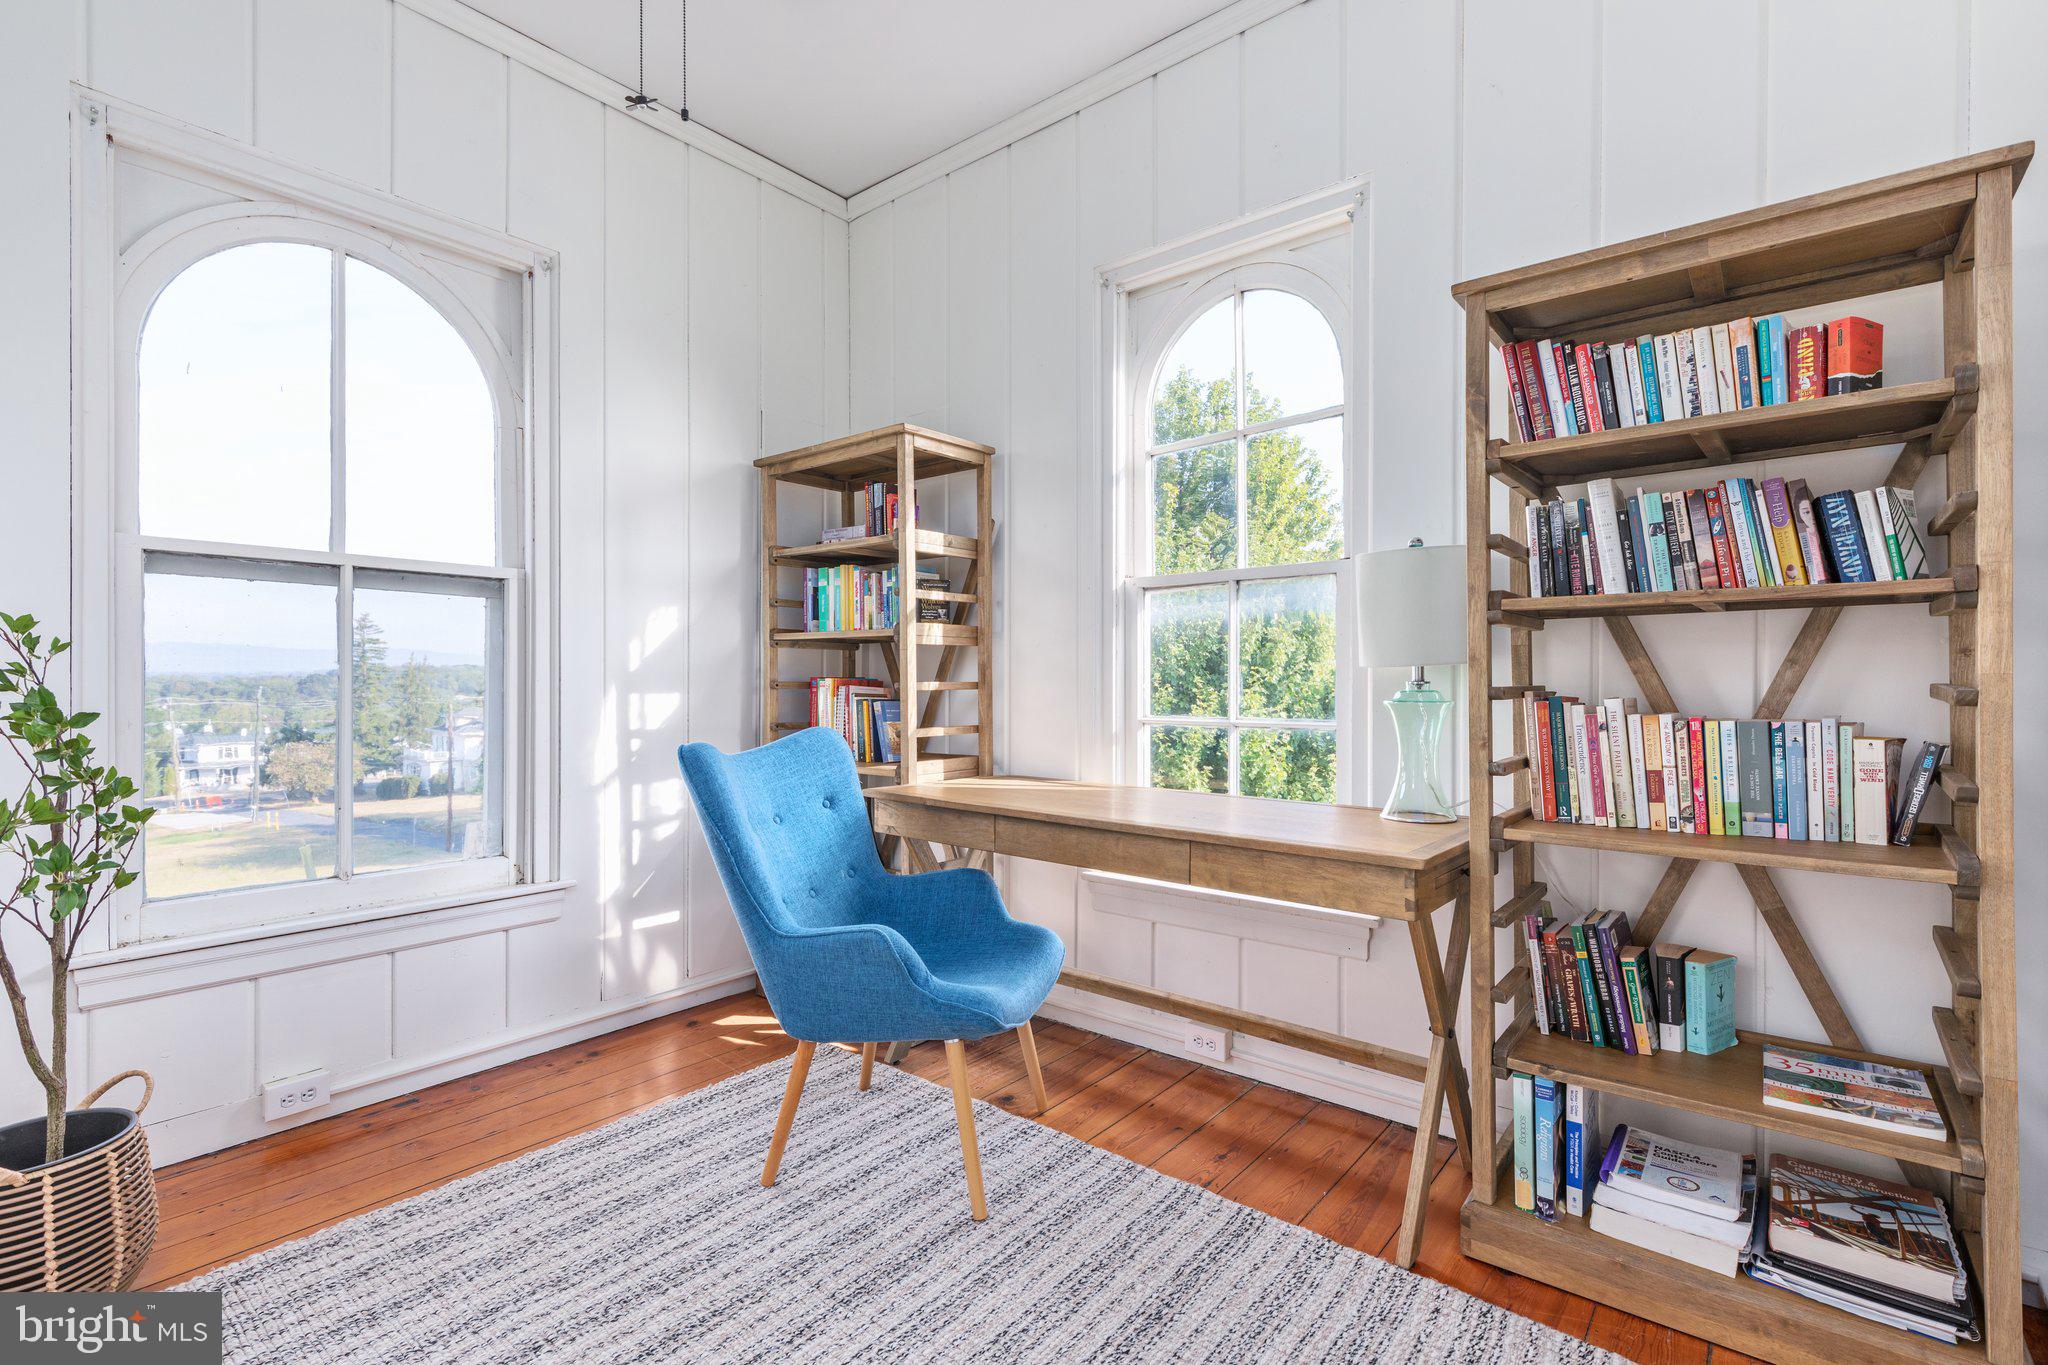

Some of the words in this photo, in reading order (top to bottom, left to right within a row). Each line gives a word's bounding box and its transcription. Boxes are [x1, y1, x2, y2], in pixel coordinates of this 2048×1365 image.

[1520, 346, 1530, 357] THE
[1523, 359, 1532, 367] DA
[1578, 350, 1589, 377] CHELSEA
[1525, 367, 1535, 383] VINCI
[1558, 373, 1566, 388] People
[1567, 364, 1578, 384] MYTH
[1528, 384, 1538, 398] CODE
[1583, 377, 1593, 404] HANDLER
[1532, 402, 1541, 414] DAN
[1570, 385, 1586, 425] CONTAGION
[1534, 415, 1546, 436] BROWN
[1772, 492, 1780, 503] The
[1665, 510, 1674, 523] CITY
[1735, 510, 1743, 520] the
[1769, 502, 1785, 523] Help
[1825, 494, 1850, 528] AYN
[1737, 521, 1746, 537] lotus
[1623, 540, 1630, 548] Go
[1669, 532, 1679, 555] THIEVES
[1715, 538, 1725, 556] Life
[1570, 553, 1579, 567] KITE
[1653, 539, 1661, 572] TRAVELER'S
[1718, 555, 1727, 565] of
[1835, 533, 1863, 578] RAND
[1721, 566, 1730, 576] Pi
[1571, 569, 1581, 594] RUNNER
[1611, 725, 1619, 747] SILENT
[1575, 724, 1586, 774] Transcendence
[1774, 747, 1782, 764] BELL
[1826, 749, 1834, 764] CODE
[1613, 750, 1622, 777] PATIENT
[1922, 754, 1933, 769] 1984
[1775, 766, 1783, 779] JAR
[1913, 769, 1929, 795] ORWELL
[1827, 786, 1835, 807] VERITY
[1908, 792, 1921, 813] GEORGE
[1588, 937, 1602, 972] WARRIORS
[1598, 979, 1608, 1001] ANBAR
[1712, 967, 1731, 986] ZEN
[1564, 968, 1575, 996] GRAPES
[1611, 984, 1623, 1013] Terminology
[1569, 1001, 1580, 1028] WRATH
[1617, 1013, 1626, 1032] Medical
[1775, 1056, 1866, 1082] 35mm
[1518, 1114, 1526, 1146] sociology
[1536, 1116, 1551, 1160] Religions
[1652, 1152, 1686, 1166] Guide
[1653, 1148, 1718, 1168] Contractors
[1654, 1144, 1702, 1161] NASCLA
[1786, 1159, 1864, 1184] Carpentry
[1794, 1166, 1839, 1183] Building
[1841, 1178, 1919, 1203] Construction
